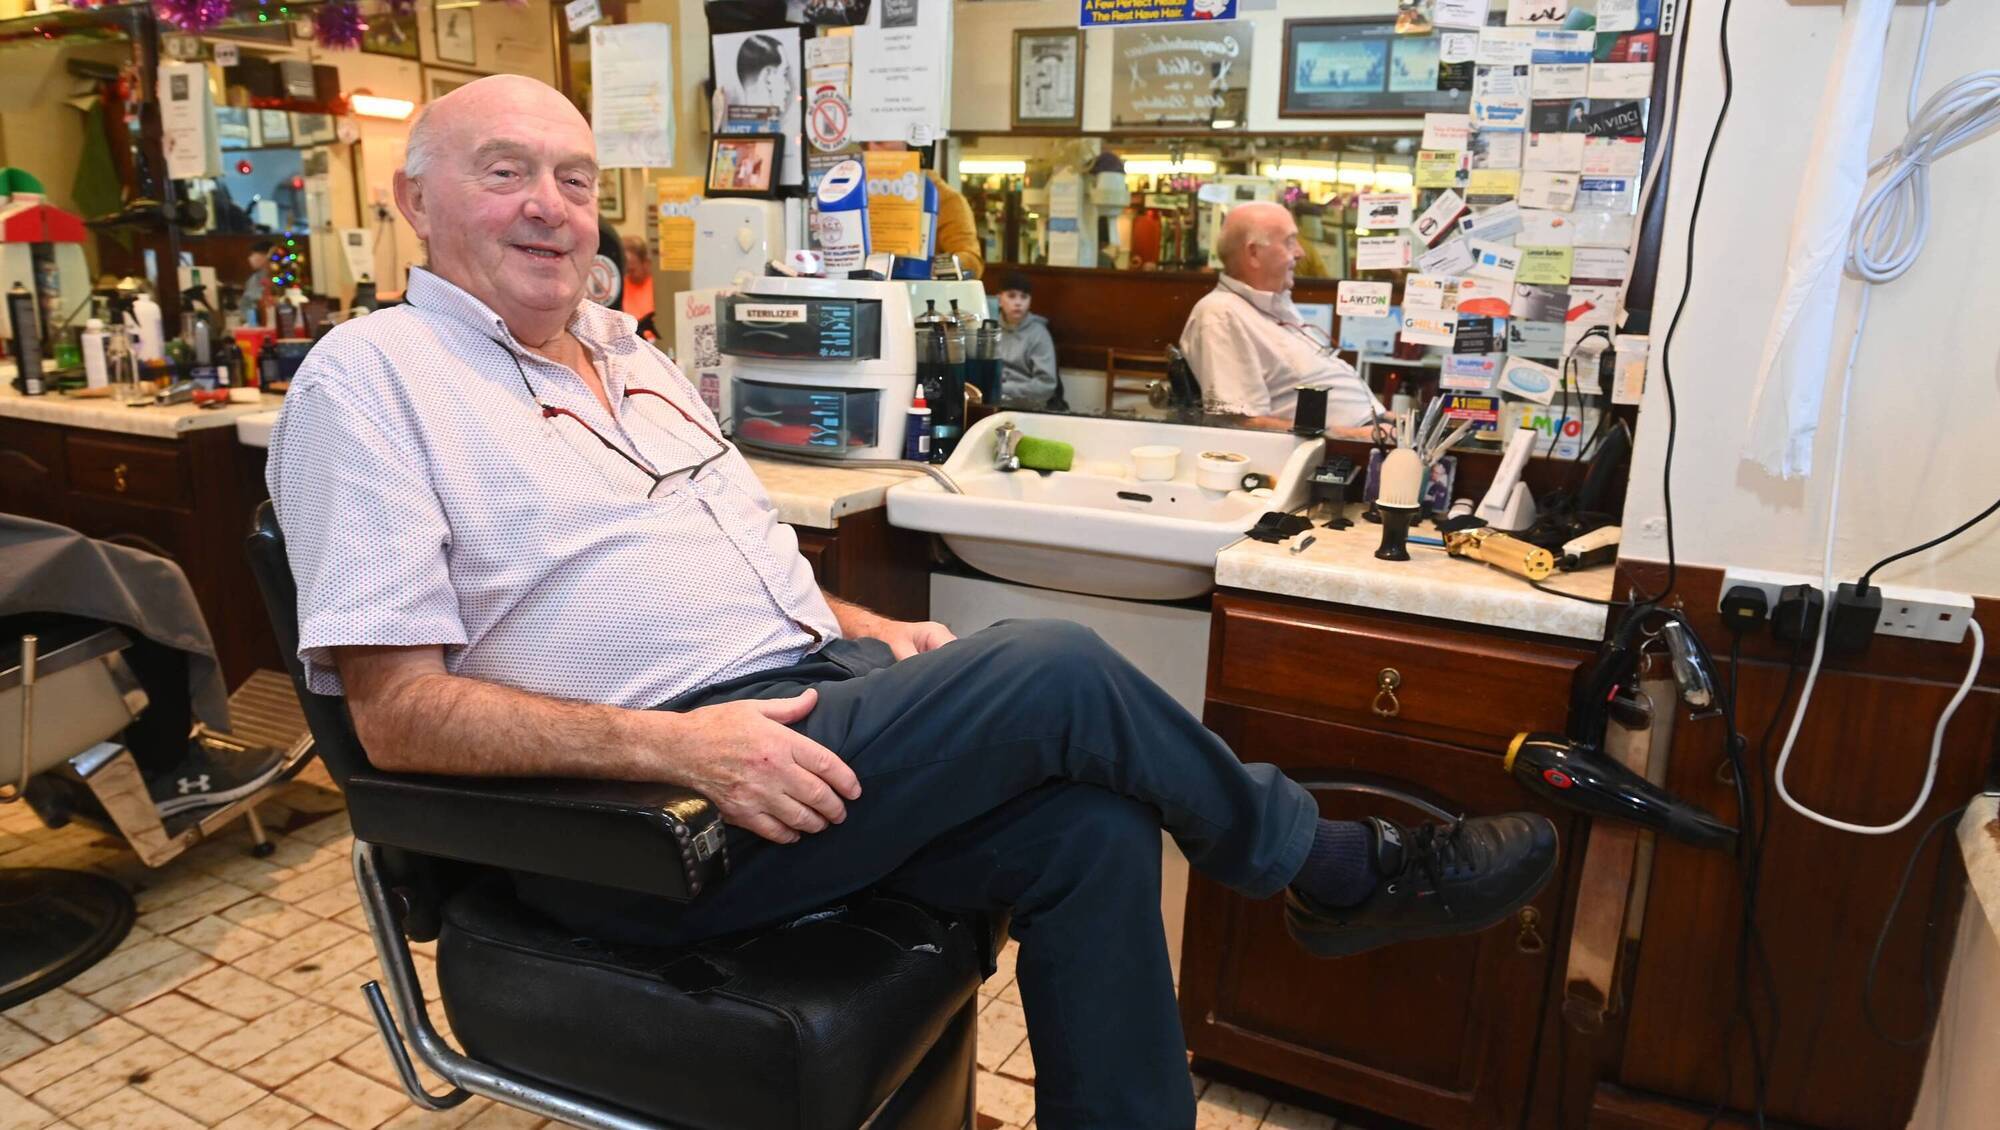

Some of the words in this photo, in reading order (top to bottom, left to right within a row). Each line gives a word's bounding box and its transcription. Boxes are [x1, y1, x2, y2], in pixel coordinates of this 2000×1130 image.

[1095, 0, 1115, 9] Few
[1092, 11, 1110, 22] The
[1111, 10, 1133, 21] Rest
[1135, 9, 1159, 19] Have
[1161, 8, 1184, 18] Hair.
[1340, 295, 1387, 305] LAWTON
[686, 295, 711, 320] Scan
[746, 309, 799, 318] STERILIZER
[1451, 397, 1467, 409] A1
